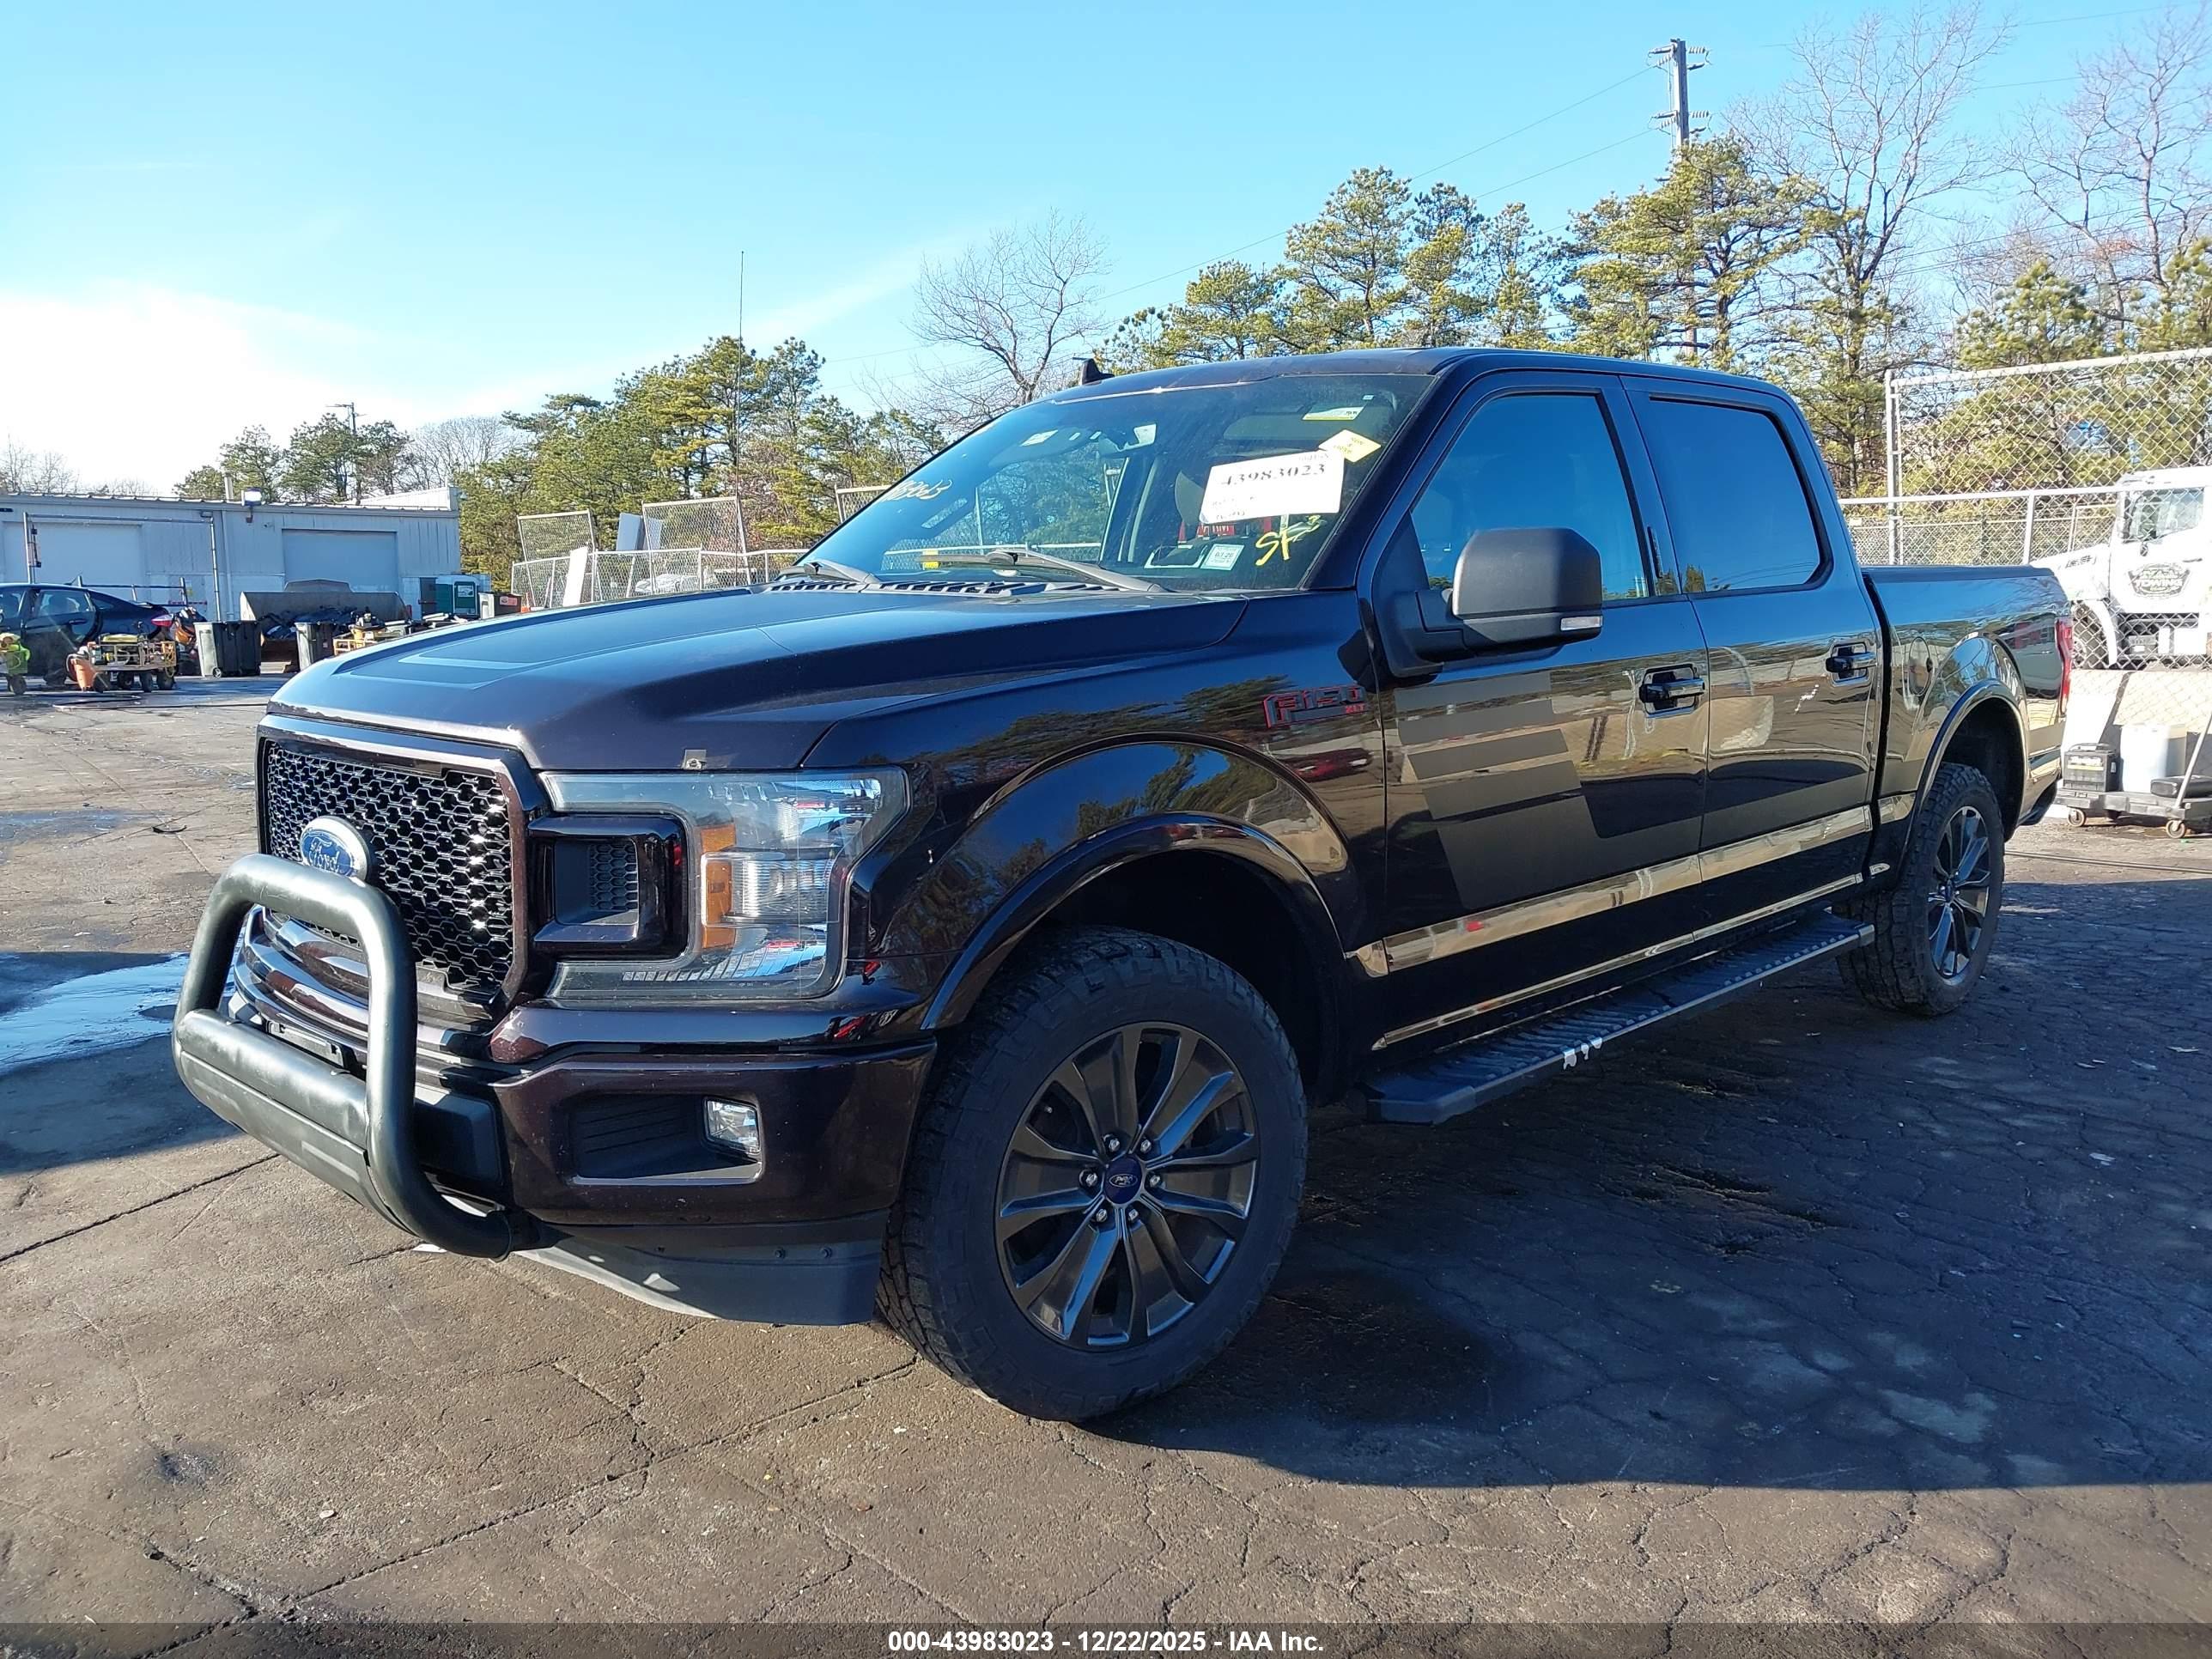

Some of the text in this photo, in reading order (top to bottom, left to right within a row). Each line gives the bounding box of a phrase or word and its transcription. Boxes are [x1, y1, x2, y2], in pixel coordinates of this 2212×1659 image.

[1220, 463, 1327, 487] 43983023
[2133, 579, 2183, 587] TOWING
[308, 836, 341, 874] Ford
